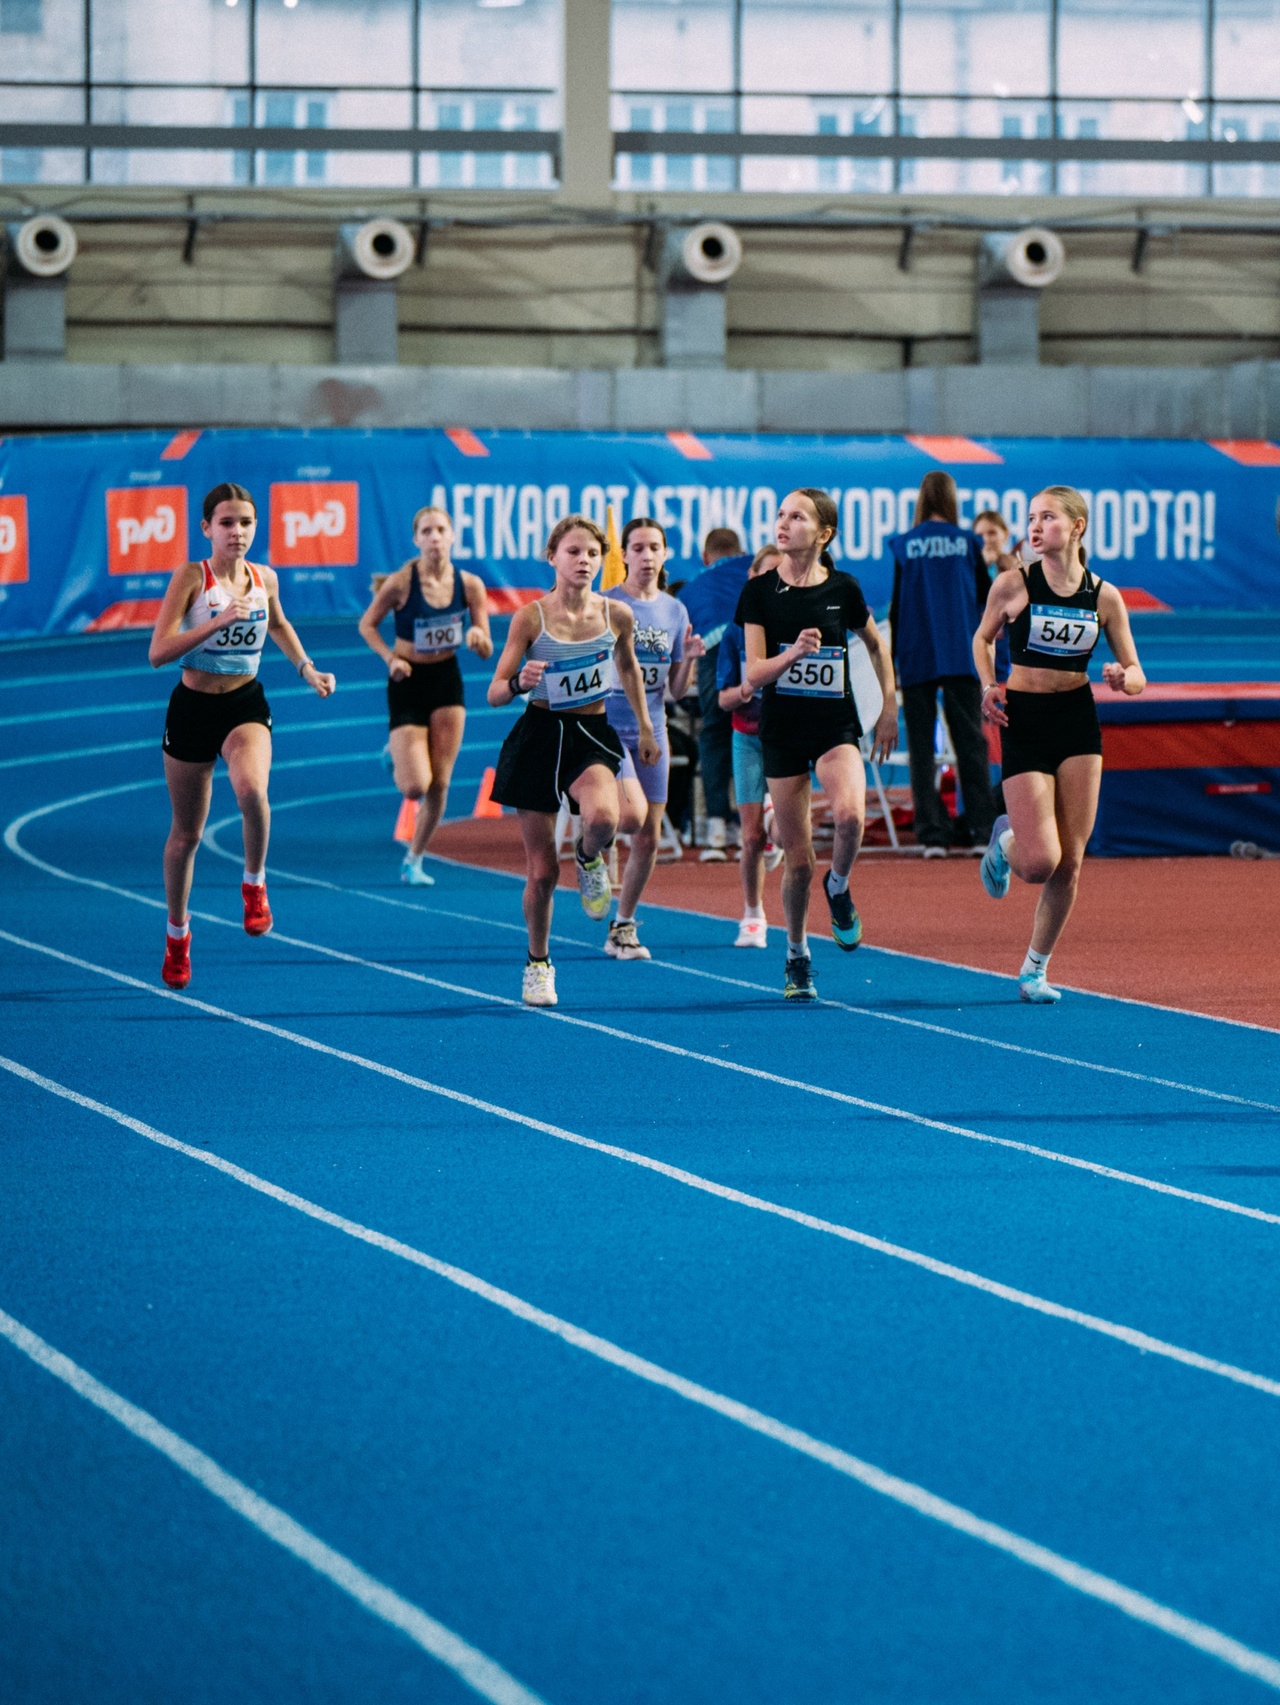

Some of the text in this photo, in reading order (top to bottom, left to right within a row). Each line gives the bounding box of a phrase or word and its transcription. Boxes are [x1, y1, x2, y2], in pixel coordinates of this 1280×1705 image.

[906, 536, 968, 559] СУДЬЯ
[216, 625, 257, 647] 356
[425, 628, 455, 647] 190
[1040, 620, 1086, 645] 547
[559, 668, 602, 696] 144
[788, 662, 834, 686] 550
